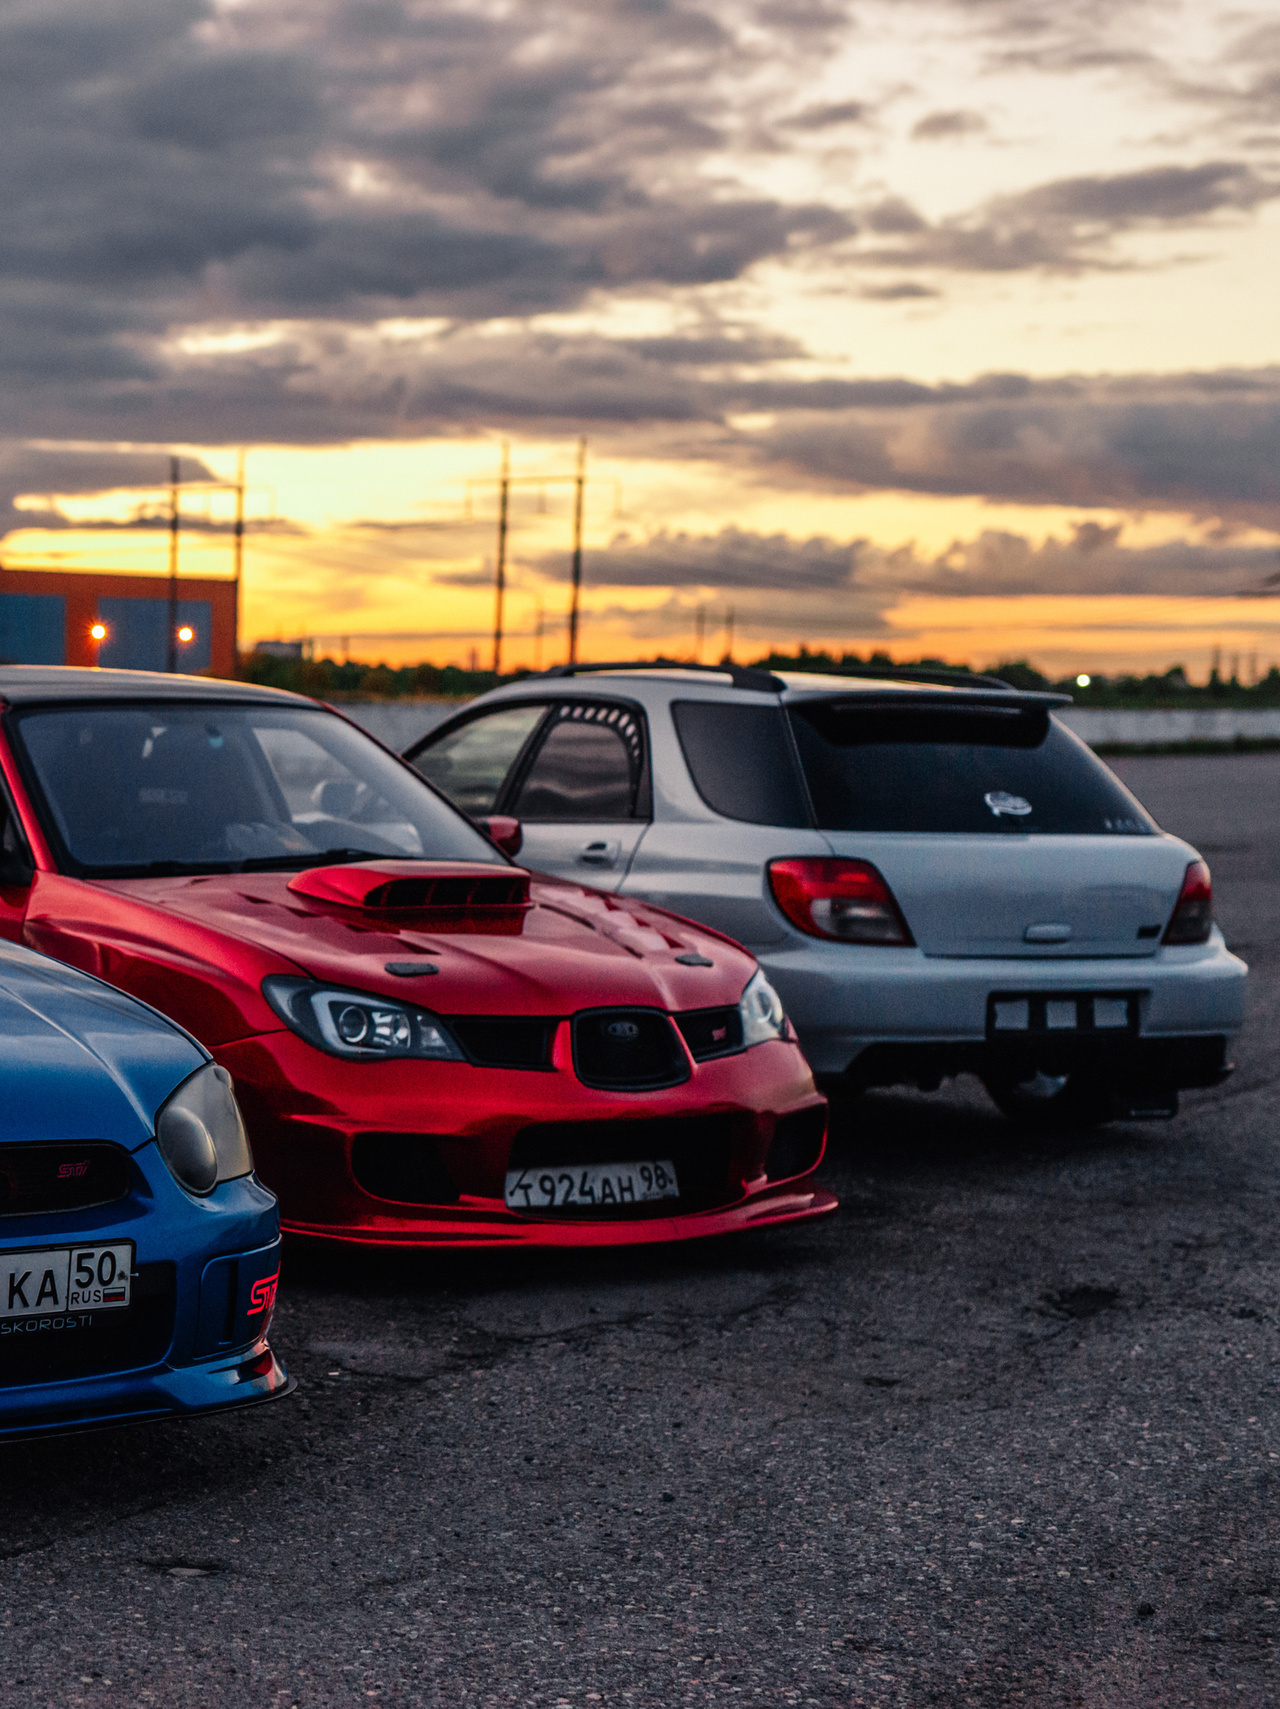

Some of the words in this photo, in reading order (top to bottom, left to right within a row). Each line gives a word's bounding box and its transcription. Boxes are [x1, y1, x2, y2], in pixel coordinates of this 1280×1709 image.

[639, 1164, 668, 1191] 98
[75, 1250, 117, 1289] 50
[70, 1289, 102, 1305] RUS
